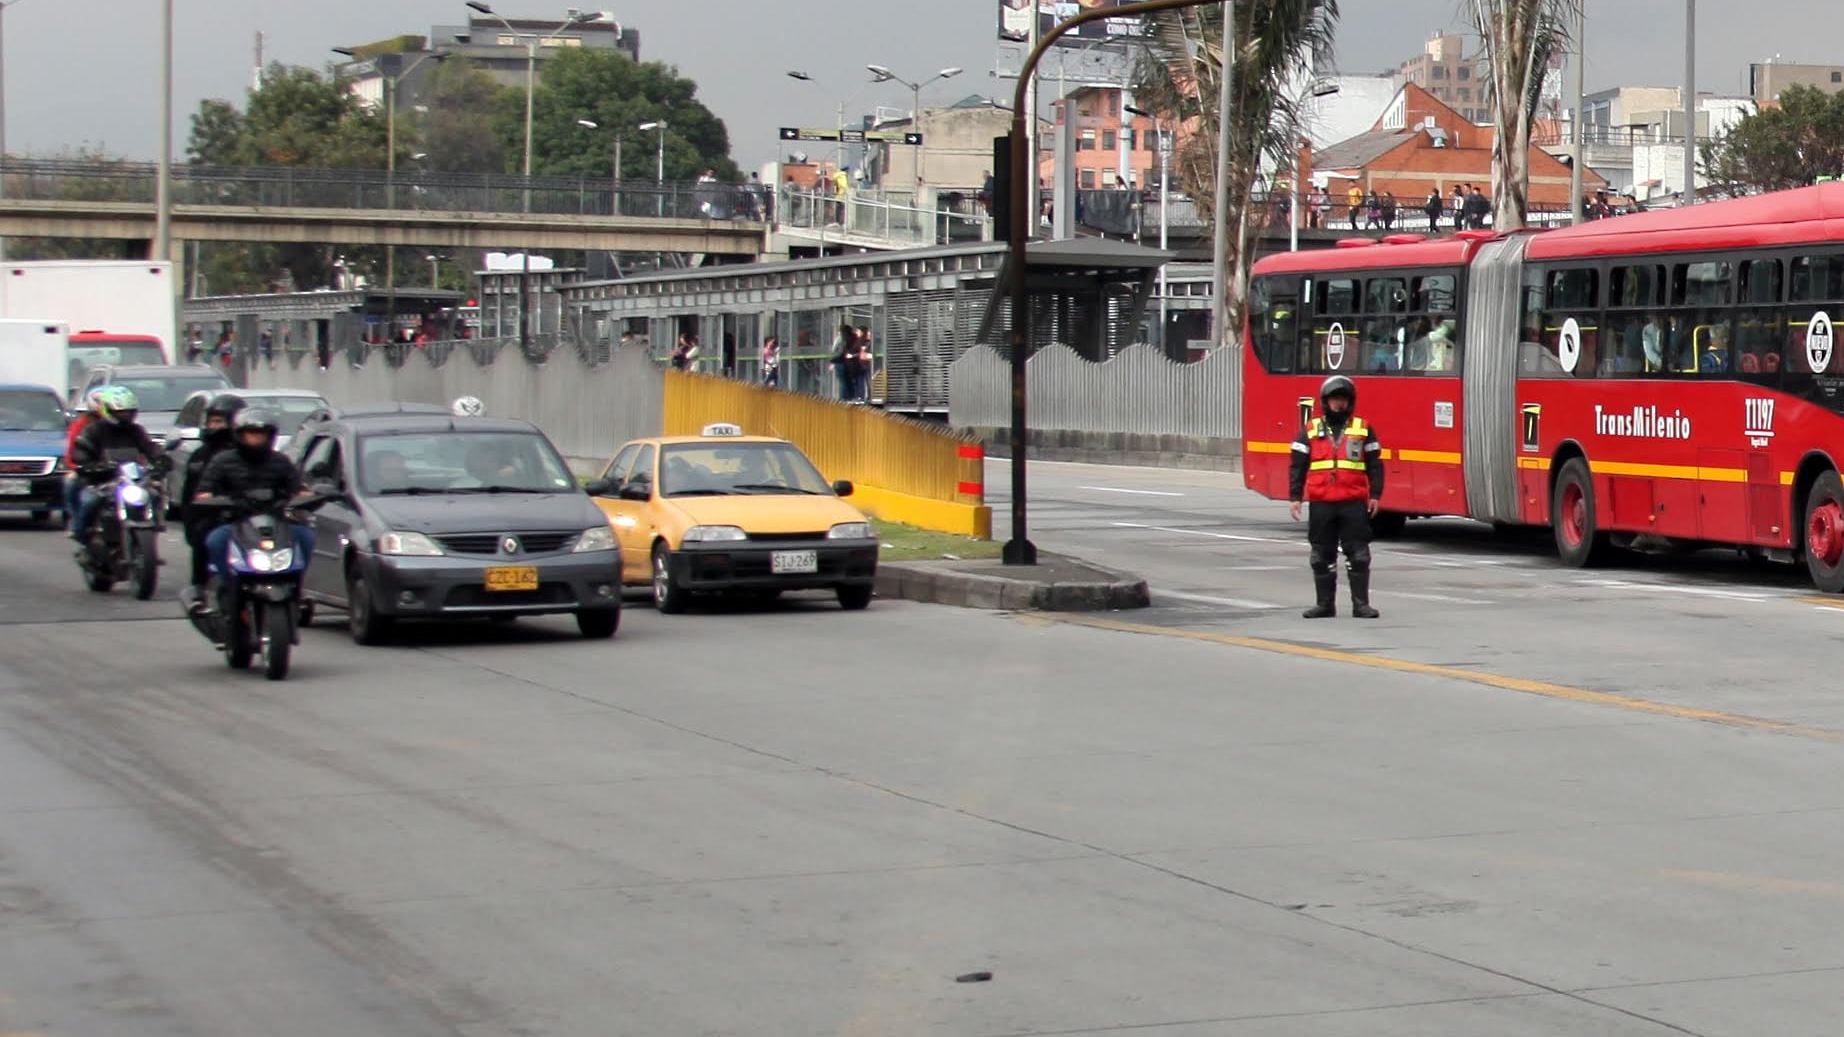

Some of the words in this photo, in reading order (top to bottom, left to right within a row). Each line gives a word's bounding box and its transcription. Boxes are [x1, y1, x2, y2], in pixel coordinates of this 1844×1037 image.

[1595, 405, 1691, 439] TransMilenio
[1745, 399, 1776, 430] T1197
[712, 427, 733, 436] TAXI
